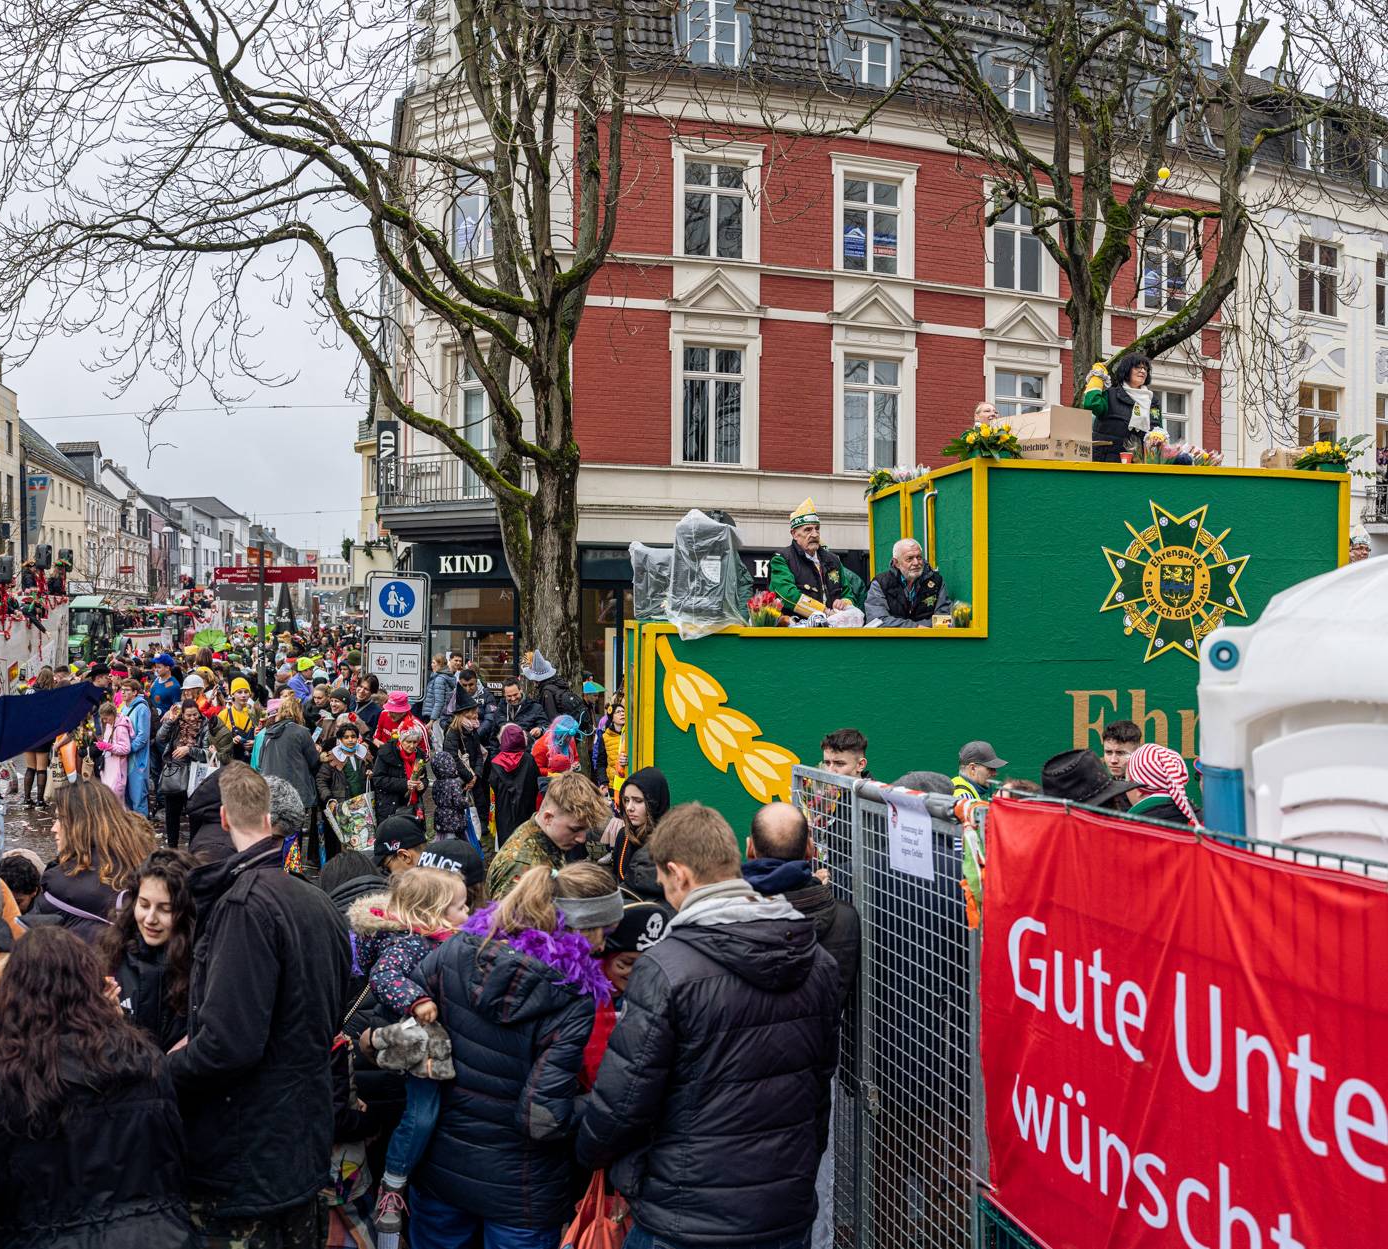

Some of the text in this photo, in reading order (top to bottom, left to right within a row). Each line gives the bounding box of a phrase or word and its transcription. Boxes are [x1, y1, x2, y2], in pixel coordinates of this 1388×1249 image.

[439, 554, 494, 574] KIND
[1151, 549, 1203, 570] Ehrengarde
[1145, 581, 1209, 618] Bergisch Gladbach
[382, 619, 411, 630] ZONE
[418, 851, 463, 873] POLICE
[1008, 916, 1388, 1184] Gute Unte
